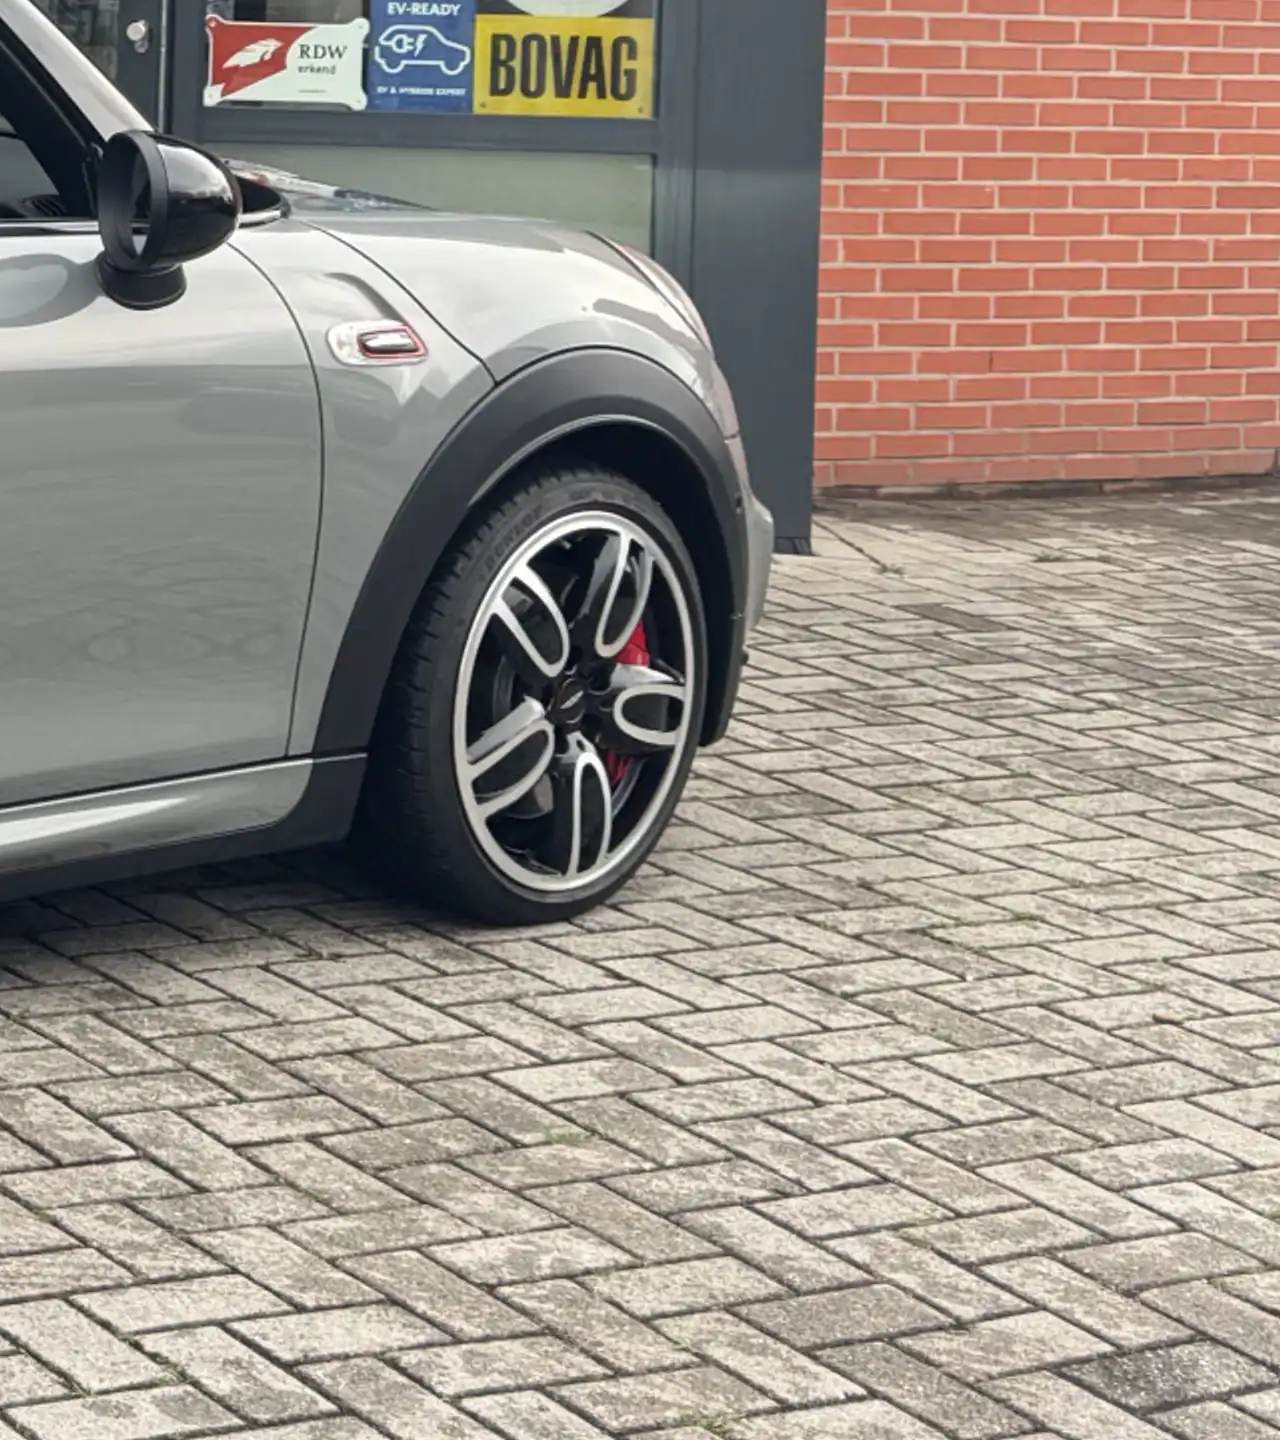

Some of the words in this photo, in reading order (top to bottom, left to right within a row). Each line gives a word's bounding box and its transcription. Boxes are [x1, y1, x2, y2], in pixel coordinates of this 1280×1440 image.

[388, 2, 461, 15] EV-READY
[298, 44, 347, 59] RDW
[298, 64, 336, 75] erkend
[490, 32, 637, 101] BOVAG
